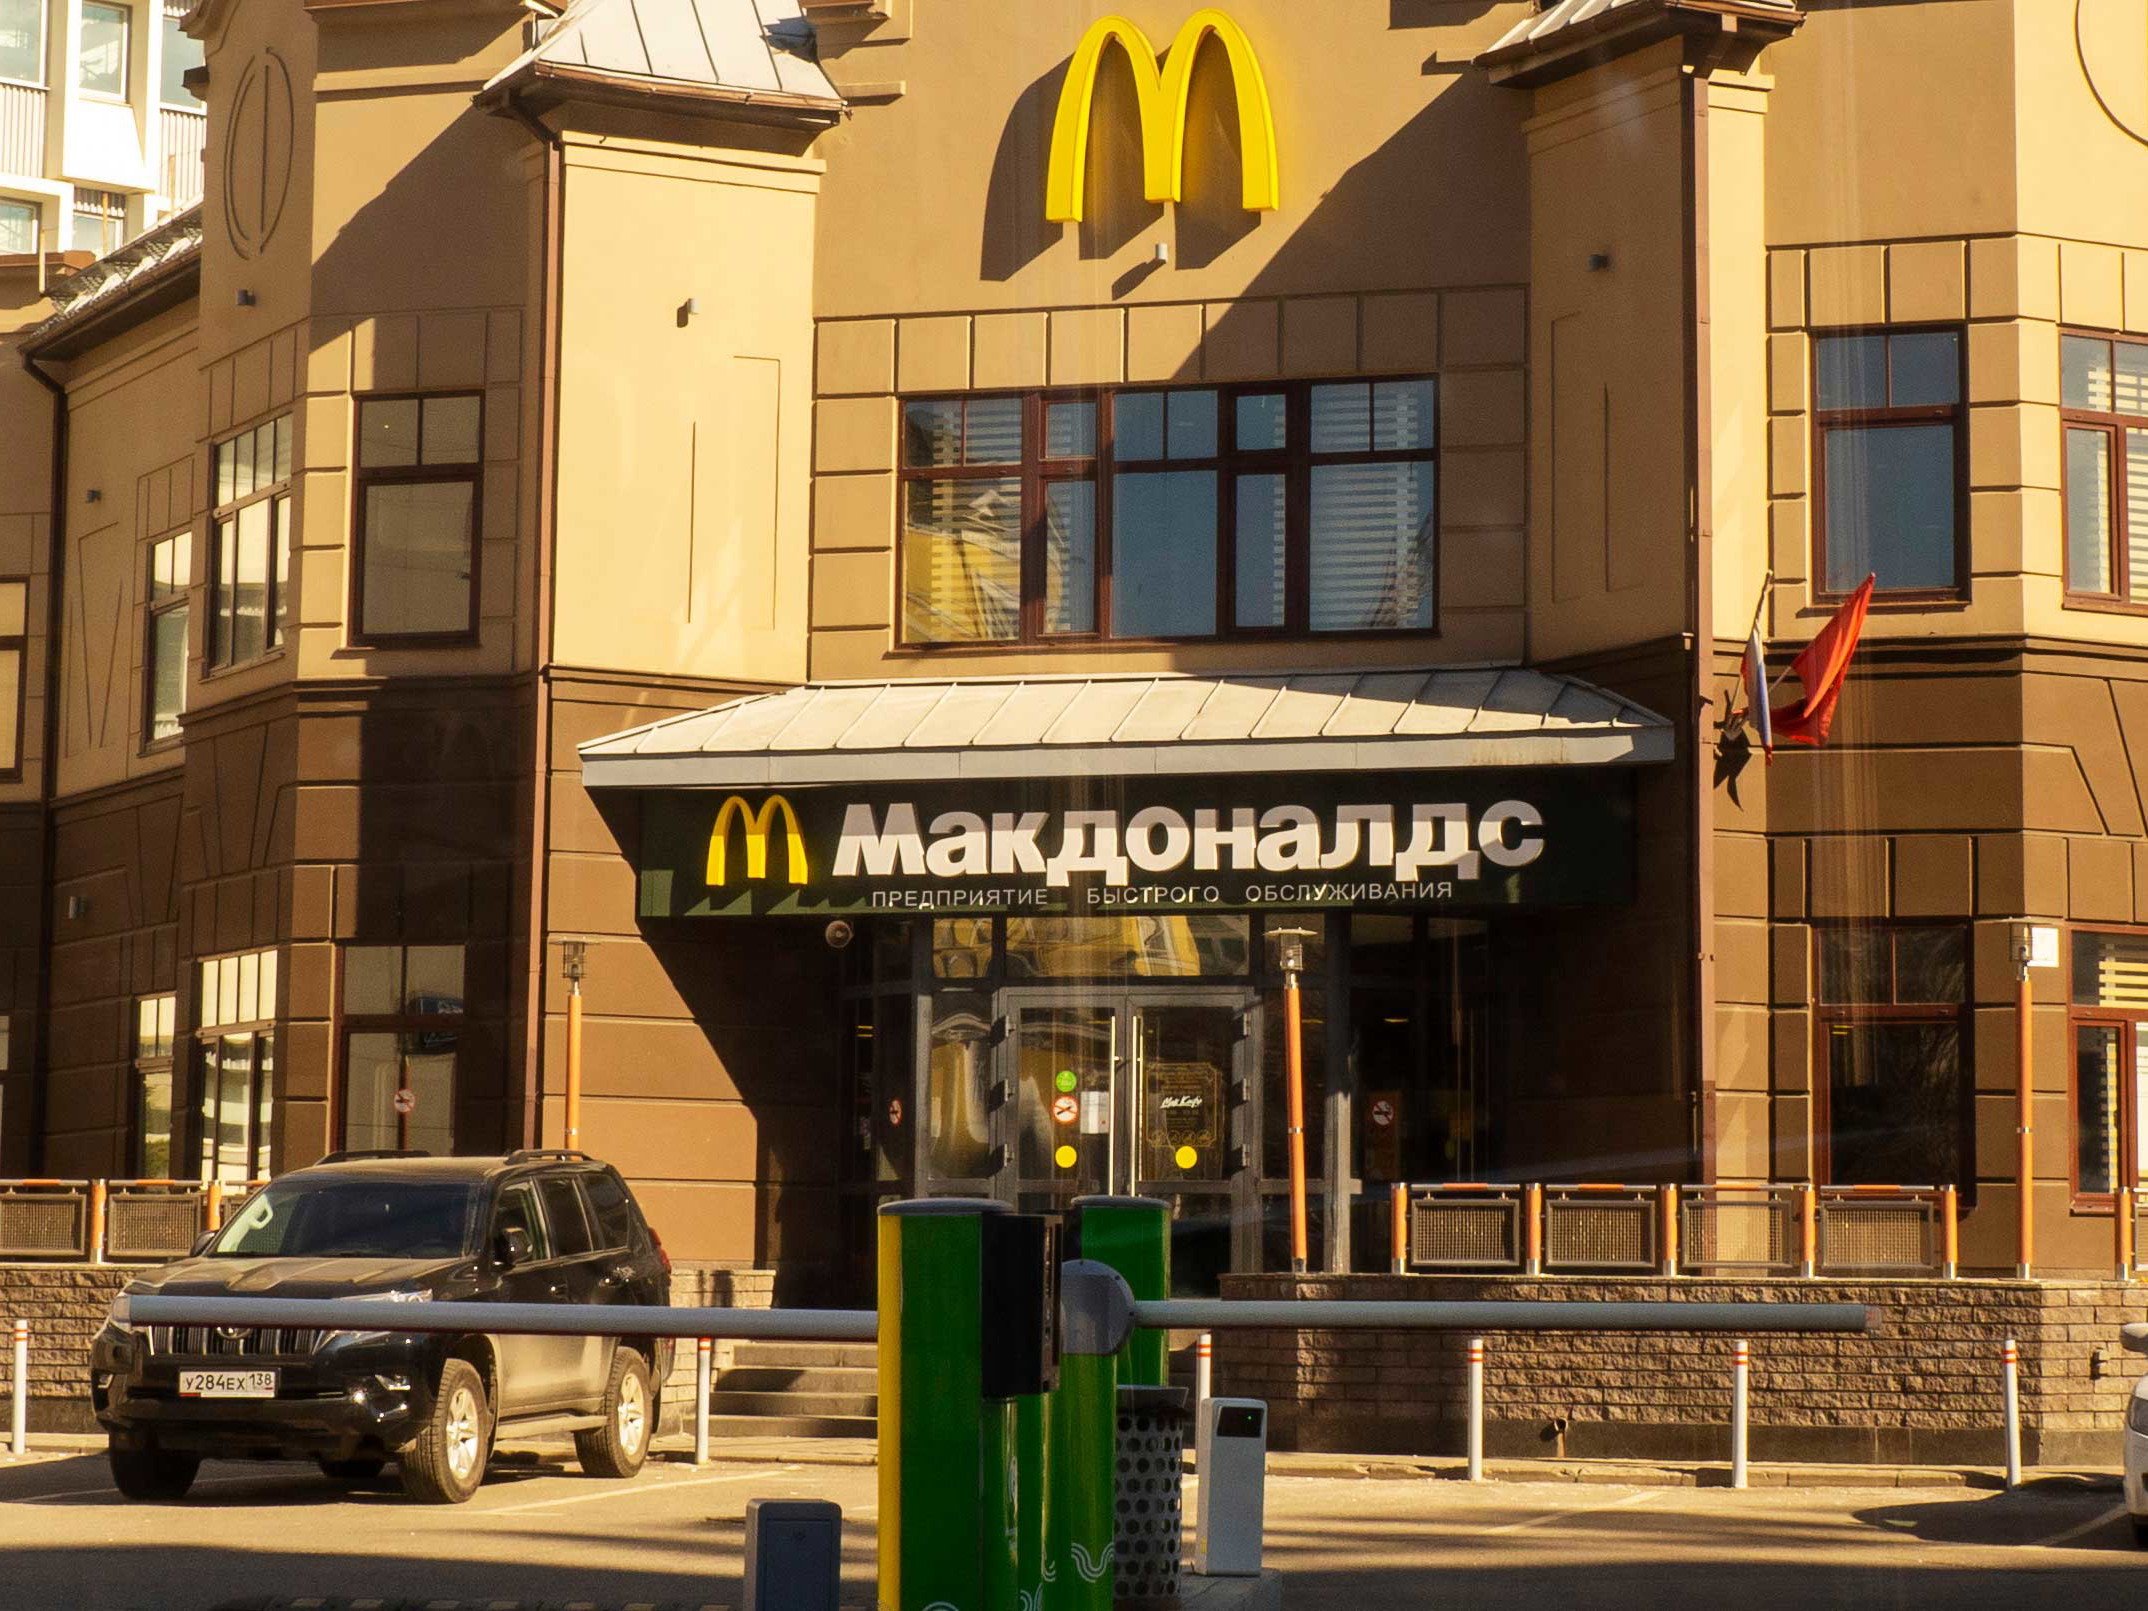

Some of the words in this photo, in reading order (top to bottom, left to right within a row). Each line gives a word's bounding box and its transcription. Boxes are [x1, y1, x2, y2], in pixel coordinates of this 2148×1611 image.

[832, 800, 1545, 886] Макдоналдс
[872, 889, 1048, 909] ПРЕДПРИЯТИЕ
[1087, 887, 1219, 904] БЫСТРОГО
[1246, 882, 1452, 901] ОБСЛУЖИВАНИЯ
